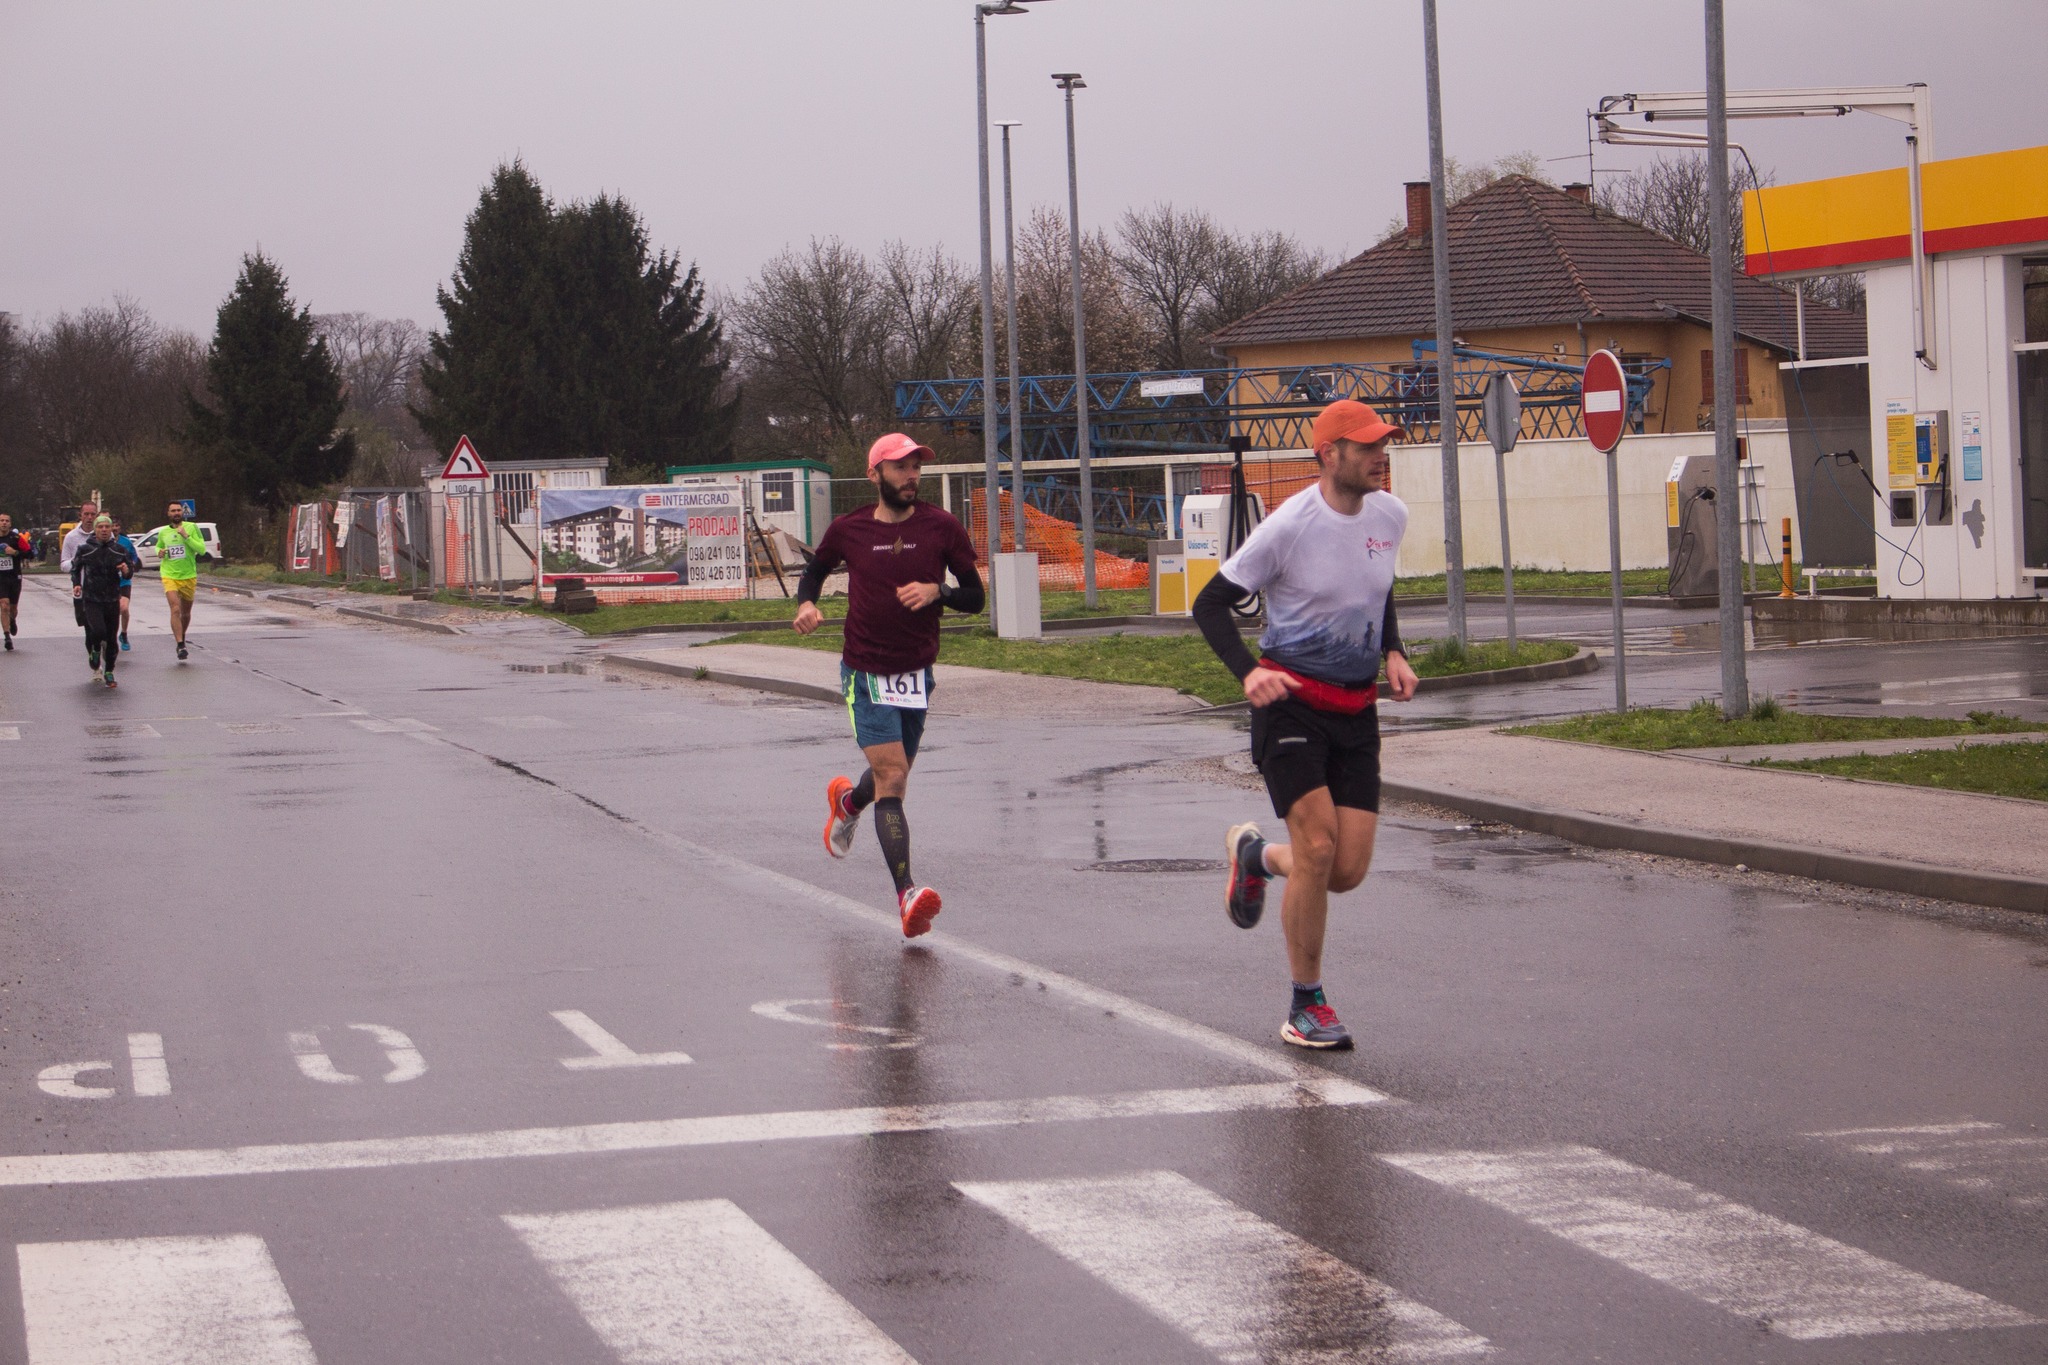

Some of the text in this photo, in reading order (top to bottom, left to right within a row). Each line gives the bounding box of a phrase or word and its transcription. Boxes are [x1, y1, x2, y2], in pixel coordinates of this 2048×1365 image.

[455, 484, 467, 493] 100
[662, 493, 729, 506] INTERMEGRAD
[688, 516, 739, 536] PRODAJA
[170, 546, 185, 556] 225
[689, 546, 741, 561] 098/241 084
[0, 559, 12, 567] 201
[574, 575, 644, 584] w.intermegrad.hr
[690, 565, 742, 581] 098/426 370
[885, 672, 922, 695] 161
